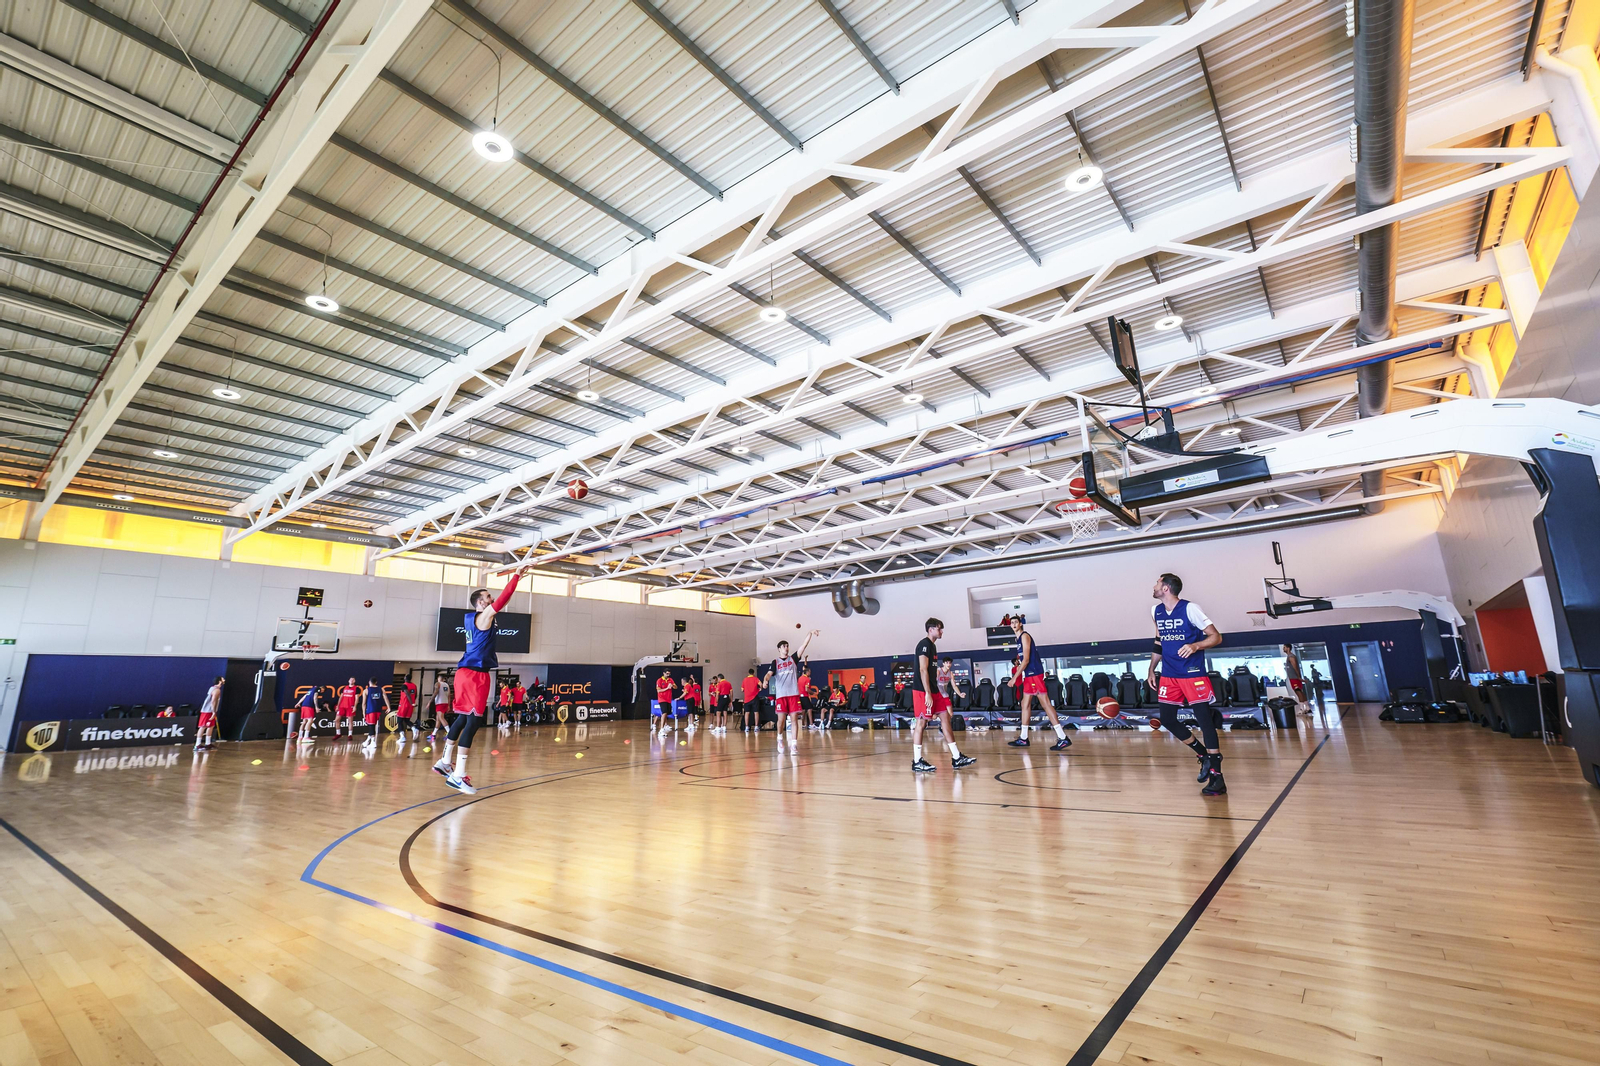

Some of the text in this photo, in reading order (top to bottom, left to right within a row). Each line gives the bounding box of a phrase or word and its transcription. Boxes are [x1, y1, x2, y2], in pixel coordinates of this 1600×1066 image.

[1157, 619, 1184, 630] ESP
[777, 661, 793, 669] ESP
[33, 728, 53, 746] 100
[80, 724, 185, 742] finetwork
